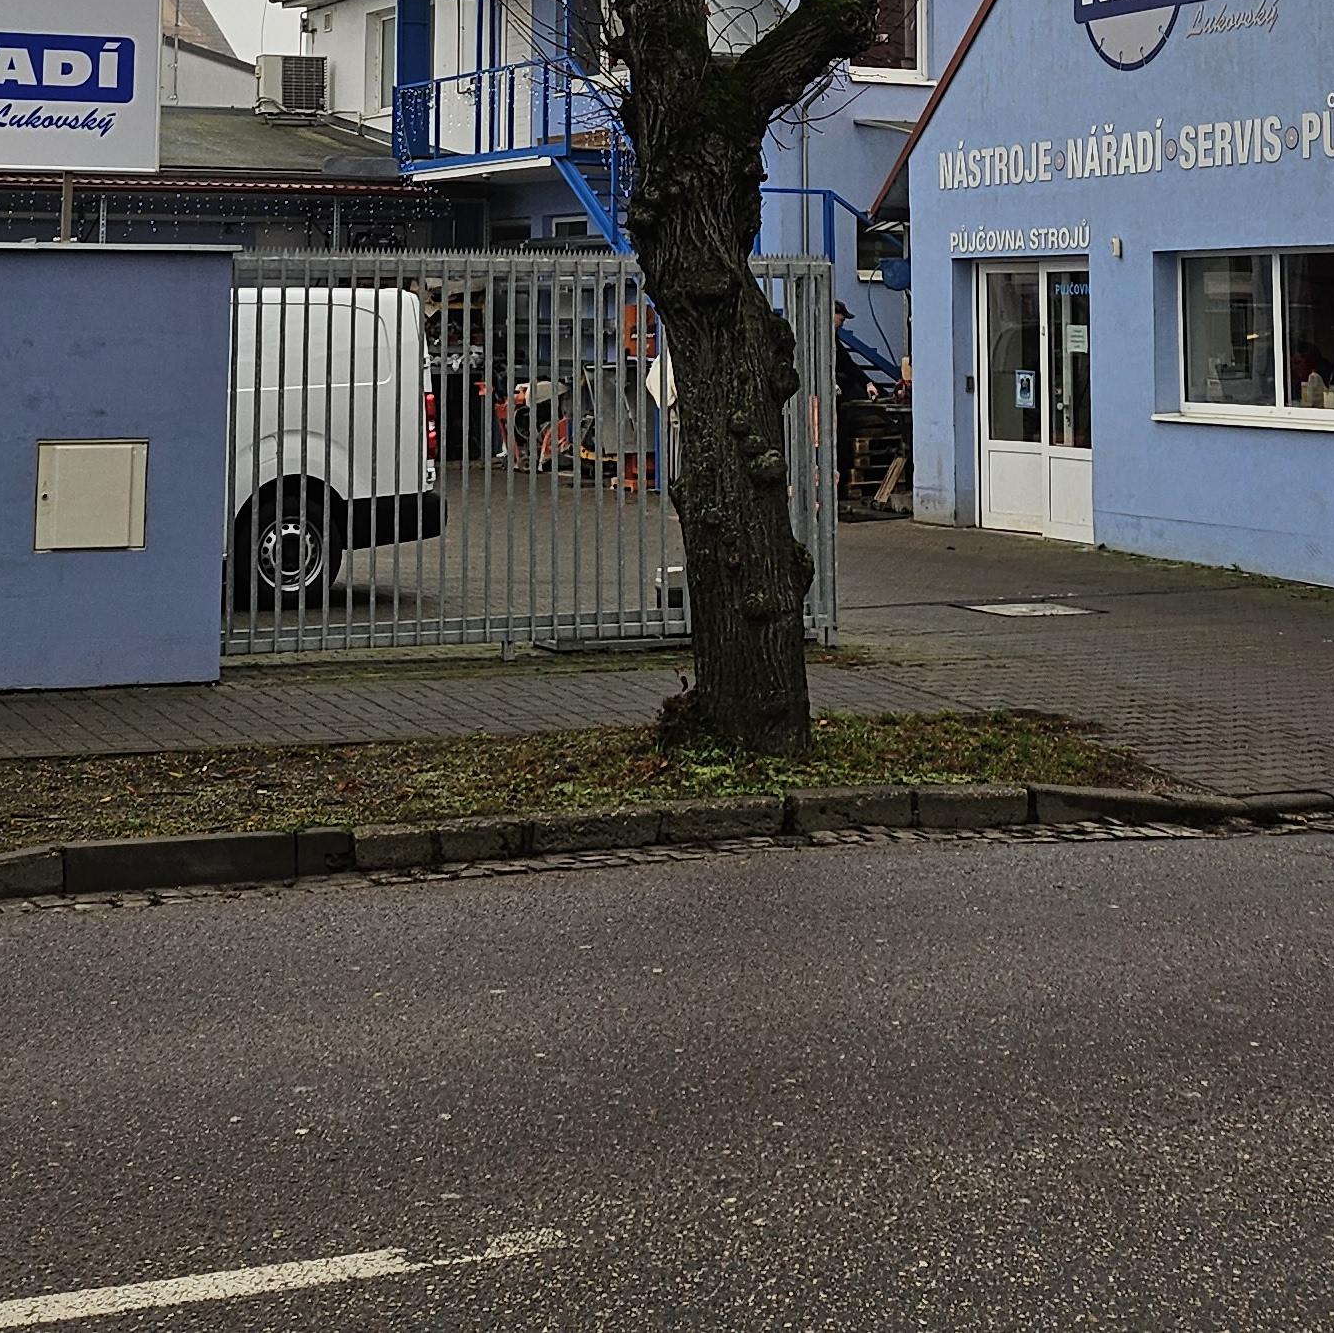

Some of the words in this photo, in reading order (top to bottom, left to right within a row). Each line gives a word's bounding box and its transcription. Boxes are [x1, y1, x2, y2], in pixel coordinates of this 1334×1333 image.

[939, 139, 1053, 191] NÁSTROJE
[1067, 117, 1163, 179] NÁŘADÍ
[1179, 115, 1283, 170] SERVIS
[950, 224, 1026, 254] PŮJČOVNA
[1029, 218, 1091, 250] STROJŮ
